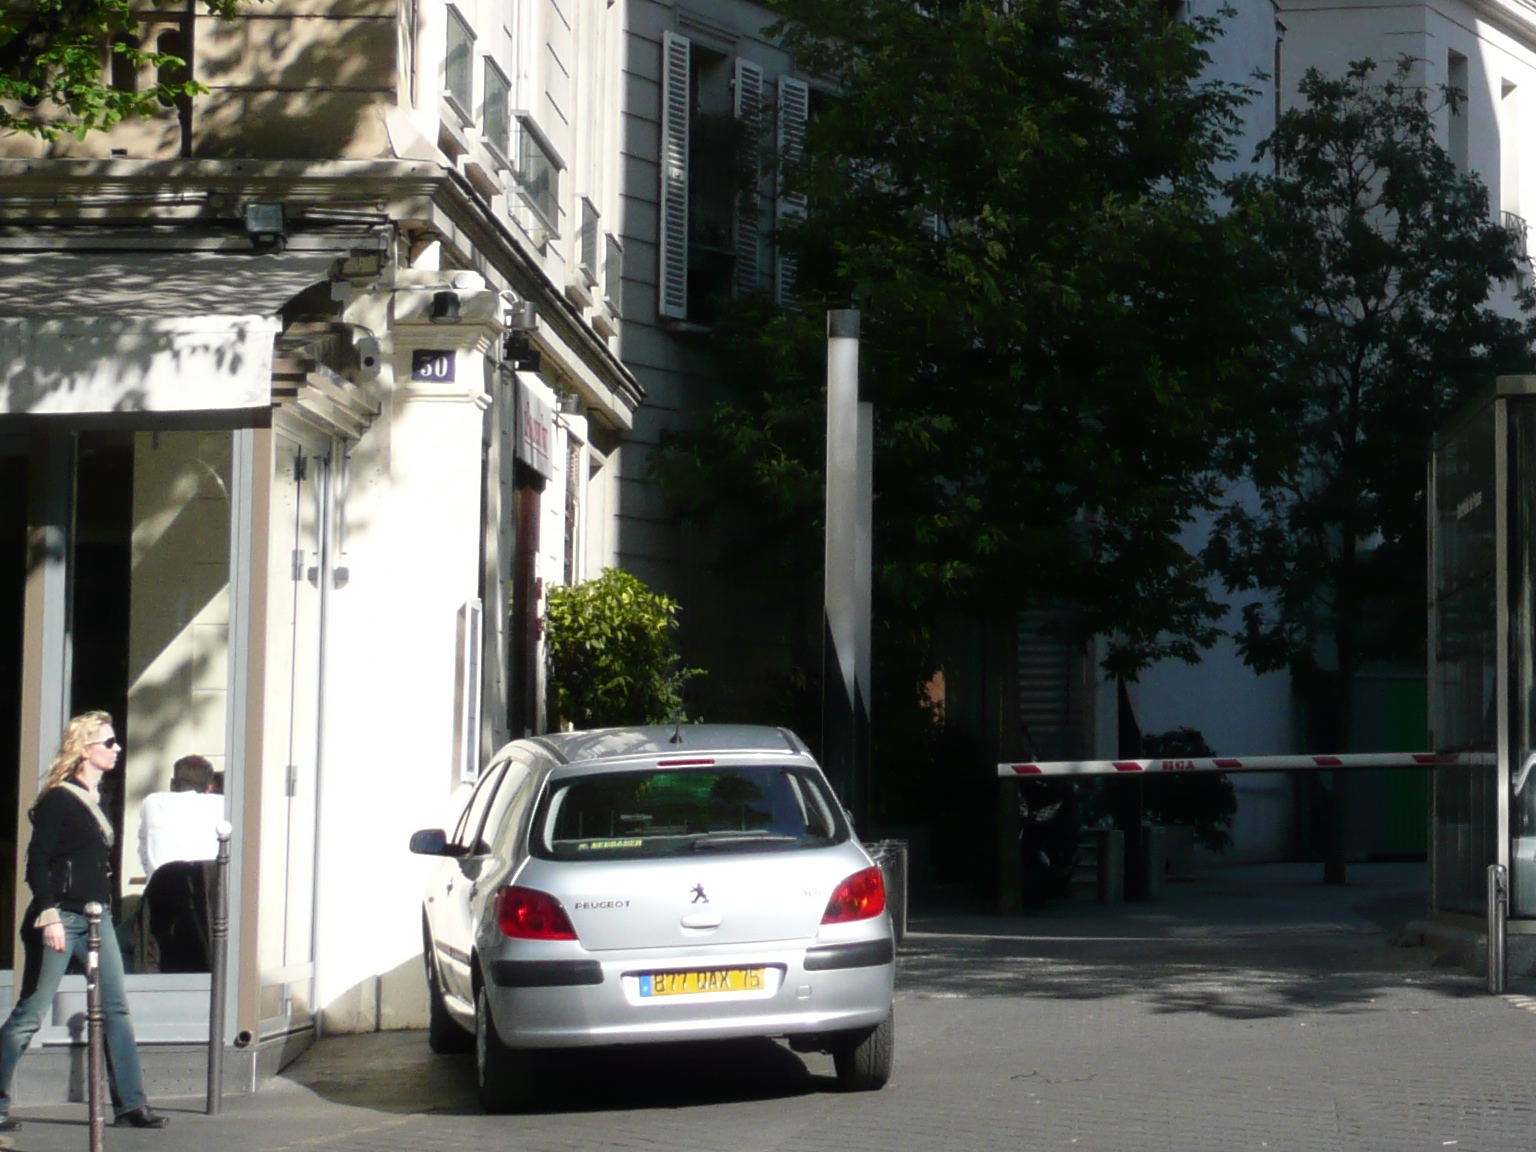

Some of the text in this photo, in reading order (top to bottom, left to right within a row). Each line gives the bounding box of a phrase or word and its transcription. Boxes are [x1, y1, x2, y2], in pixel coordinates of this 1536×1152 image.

[420, 355, 448, 377] 30
[574, 900, 631, 910] PEUGEOT
[739, 967, 760, 987] 75
